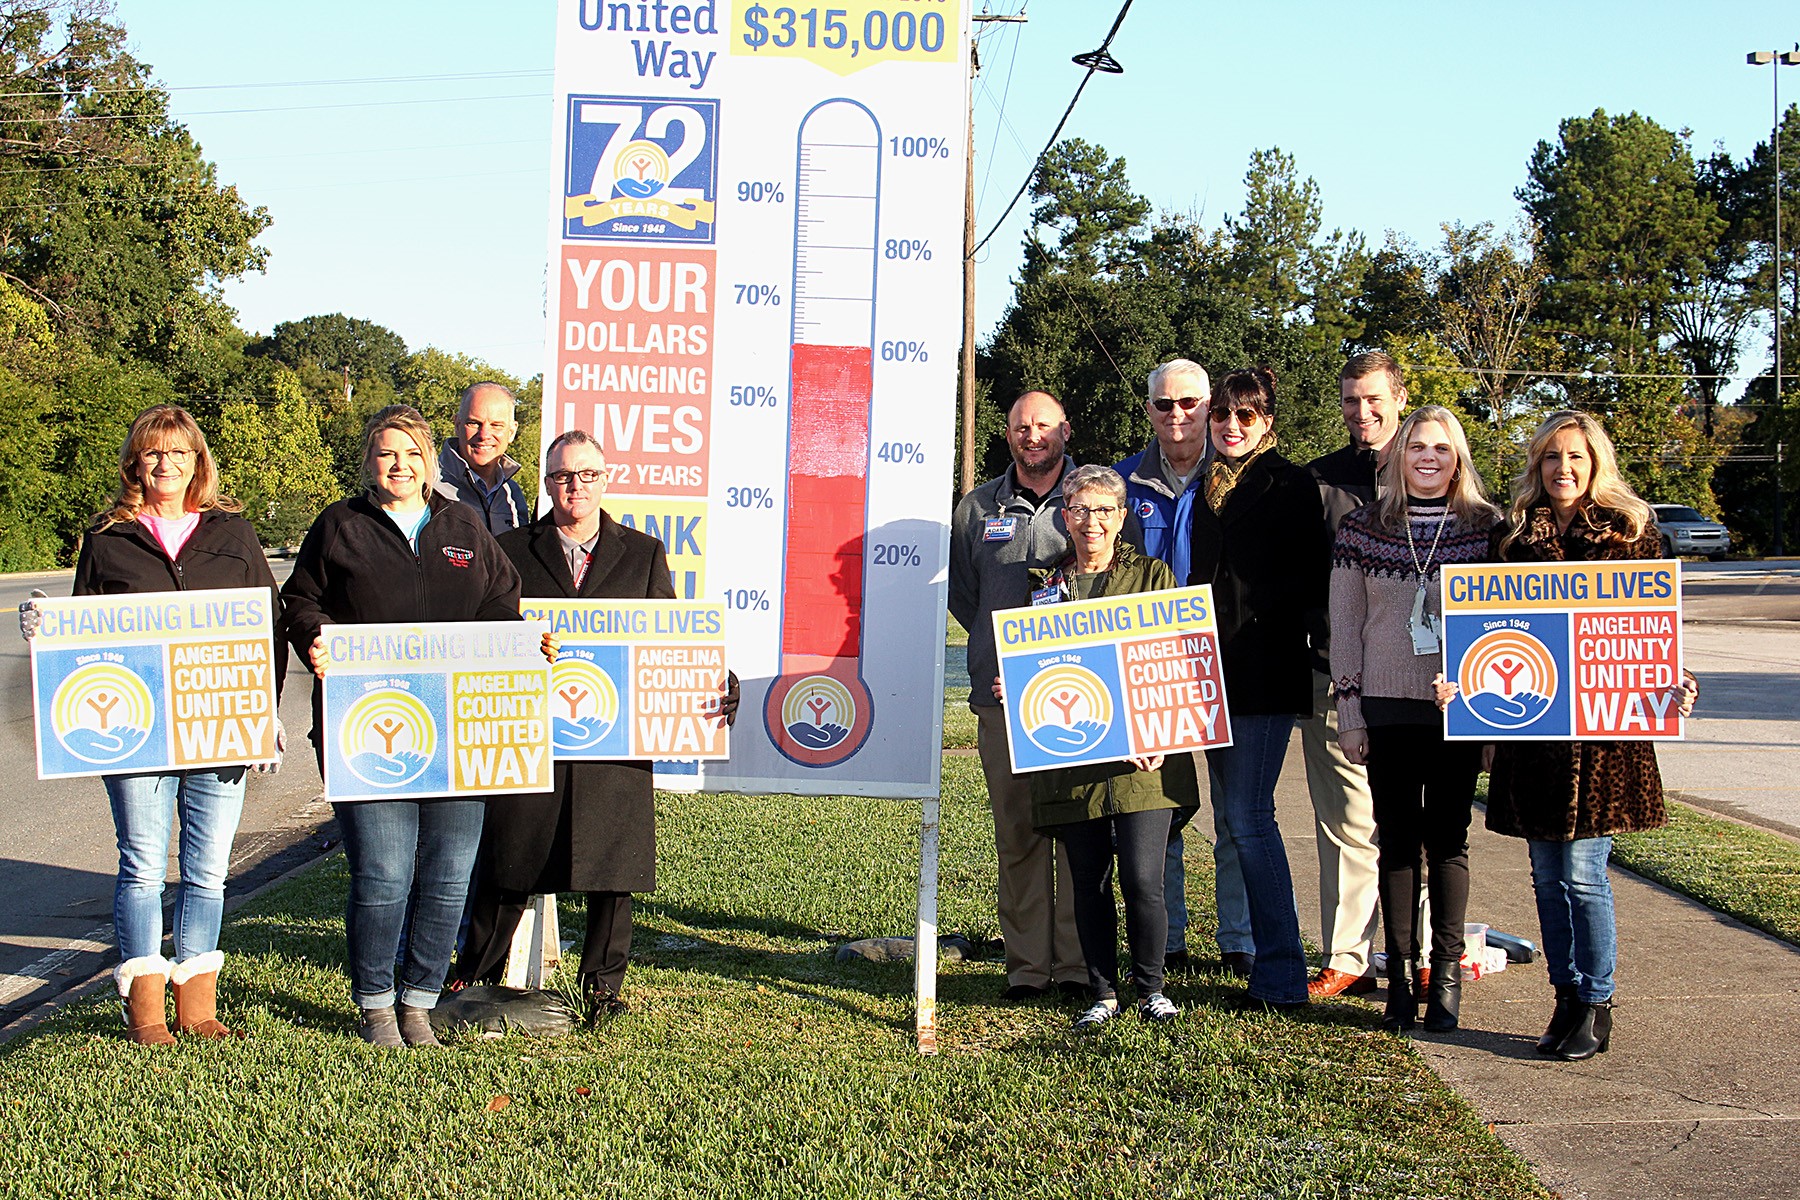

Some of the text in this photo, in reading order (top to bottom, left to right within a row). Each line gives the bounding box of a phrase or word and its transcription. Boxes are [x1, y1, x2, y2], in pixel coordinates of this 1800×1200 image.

[579, 0, 718, 34] United
[743, 3, 945, 58] $315,000
[631, 40, 717, 90] Way
[581, 104, 707, 205] 72
[890, 136, 949, 159] 100%
[737, 182, 784, 203] 90%
[609, 201, 670, 217] YEARS
[612, 222, 666, 234] Since 1948
[885, 240, 932, 261] 80%
[567, 259, 708, 314] YOUR
[734, 284, 781, 306] 70%
[565, 320, 708, 355] DOLLARS
[881, 341, 928, 363] 60%
[562, 363, 706, 395] CHANGING
[730, 386, 777, 407] 50%
[877, 442, 924, 464] 40%
[606, 463, 702, 487] 72 YEARS
[726, 487, 774, 509] 30%
[873, 543, 921, 566] 20%
[1449, 571, 1672, 603] CHANGING LIVES
[724, 589, 770, 611] 10%
[40, 599, 264, 637] CHANGING LIVES
[655, 610, 721, 634] LIVES
[1002, 596, 1207, 645] CHANGING LIVES
[1483, 619, 1531, 632] Since 1948
[1578, 616, 1673, 636] ANGELINA
[173, 642, 266, 666] ANGELINA
[330, 631, 541, 662] CHANGING LIVES
[558, 649, 595, 660] nce 1948
[638, 649, 722, 666] ANGELINA
[1126, 636, 1213, 663] ANGELINA
[1579, 638, 1673, 661] COUNTY
[75, 653, 100, 666] Since
[1037, 654, 1082, 669] Since 1948
[1129, 656, 1214, 686] COUNTY
[174, 664, 266, 691] COUNTY
[364, 679, 388, 691] Since
[456, 674, 544, 694] ANGELINA
[638, 668, 722, 689] COUNTY
[1579, 663, 1673, 689] UNITED
[175, 689, 268, 719] UNITED
[457, 694, 544, 719] COUNTY
[638, 692, 721, 714] UNITED
[1131, 679, 1217, 711] UNITED
[1580, 692, 1675, 731] WAY
[457, 719, 545, 746] UNITED
[639, 716, 722, 752] WAY
[1134, 703, 1220, 749] WAY
[177, 716, 270, 761] WAY
[458, 745, 546, 788] WAY
